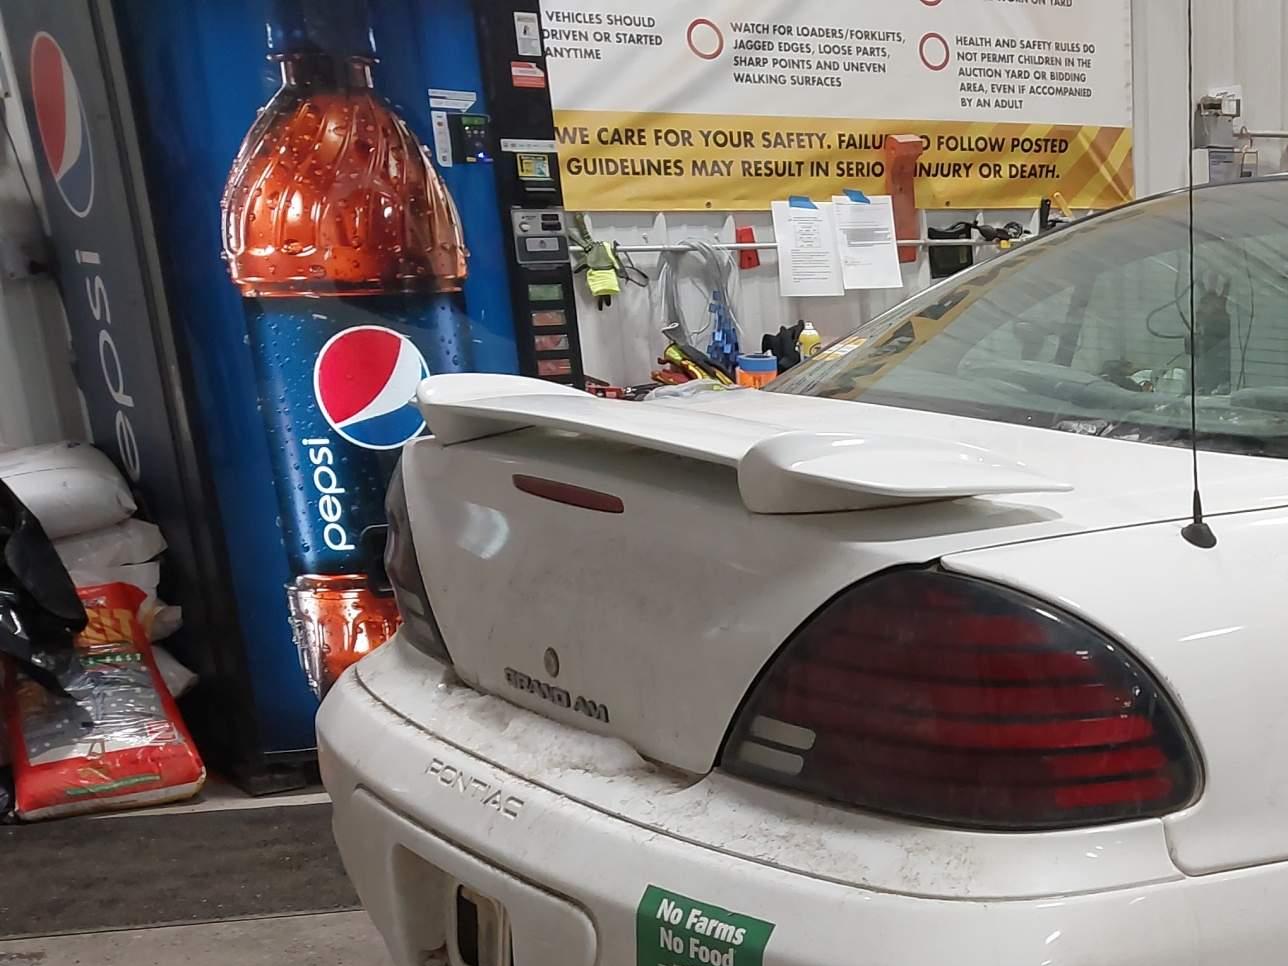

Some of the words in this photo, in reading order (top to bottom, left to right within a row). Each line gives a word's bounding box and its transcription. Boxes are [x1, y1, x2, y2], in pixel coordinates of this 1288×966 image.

[546, 10, 602, 24] VEHICLES
[607, 14, 656, 28] SHOULD
[542, 29, 588, 42] DRIVEN
[593, 32, 612, 42] OR
[616, 33, 662, 46] STARTED
[730, 22, 770, 34] WATCH
[772, 24, 793, 36] FOR
[796, 26, 906, 44] LOADERS/FORKLIFTS,
[545, 46, 602, 60] ANYTIME
[733, 40, 774, 51] JAGGED
[778, 42, 816, 55] EDGES,
[818, 44, 852, 56] LOOSE
[856, 46, 890, 58] PARTS,
[956, 36, 992, 48] HEALTH
[994, 38, 1017, 48] AND
[1020, 40, 1052, 50] SAFETY
[1054, 42, 1080, 53] RULES
[1082, 44, 1095, 54] DO
[733, 56, 768, 68] SHARP
[772, 58, 812, 70] POINTS
[816, 60, 840, 71] AND
[843, 62, 886, 73] UNEVEN
[956, 52, 978, 62] NOT
[980, 53, 1014, 64] PERMIT
[1018, 54, 1062, 66] CHILDREN
[1064, 57, 1074, 67] IN
[1077, 58, 1092, 68] THE
[733, 72, 787, 85] WALKING
[790, 75, 842, 87] SURFACES
[958, 67, 1002, 79] AUCTION
[1004, 69, 1030, 80] YARD
[1034, 70, 1046, 81] OR
[1050, 72, 1086, 82] BIDDING
[960, 82, 988, 94] AREA,
[991, 84, 1015, 94] EVEN
[1018, 85, 1026, 95] IF
[1028, 86, 1092, 97] ACCOMPANIED
[960, 98, 972, 108] BY
[976, 98, 990, 108] AN
[994, 99, 1024, 110] ADULT
[554, 126, 590, 145] WE
[597, 128, 648, 146] CARE
[654, 128, 694, 147] FOR
[698, 130, 755, 148] YOUR
[762, 131, 832, 150] SAFETY.
[838, 134, 889, 150] FAILU
[937, 136, 1006, 153] FOLLOW
[1010, 137, 1069, 154] POSTED
[566, 158, 684, 176] GUIDELINES
[691, 160, 734, 177] MAY
[741, 160, 804, 178] RESULT
[810, 161, 830, 178] IN
[836, 161, 885, 178] SERIO
[914, 162, 972, 178] INJURY
[978, 163, 1002, 178] OR
[1008, 163, 1060, 179] DEATH.
[75, 249, 141, 482] epsi
[302, 438, 356, 552] pepsi
[503, 667, 571, 708] GRAND
[574, 695, 610, 723] AM
[425, 757, 525, 820] PONTIAC
[656, 898, 684, 926] No
[686, 908, 747, 946] Farms
[660, 926, 684, 954] No
